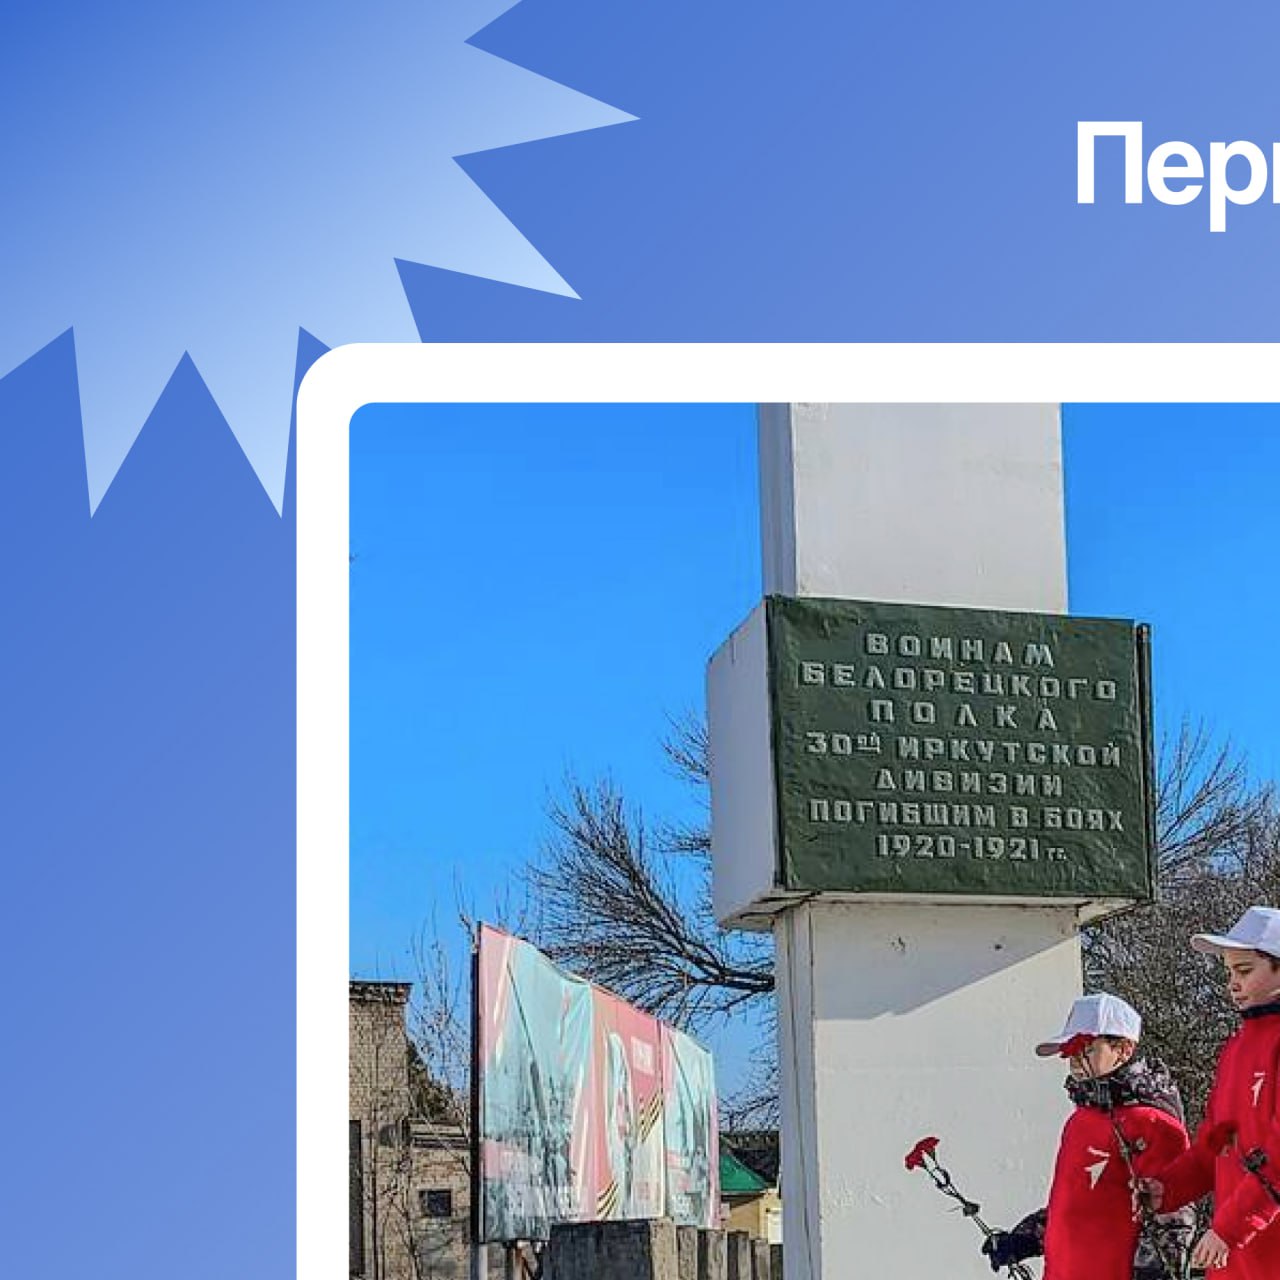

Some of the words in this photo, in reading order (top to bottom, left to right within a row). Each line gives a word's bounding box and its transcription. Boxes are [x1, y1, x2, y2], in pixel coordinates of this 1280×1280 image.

[866, 633, 1055, 666] ВОИНАМ
[802, 661, 1117, 699] БЕЛОРЕЦКОГО
[869, 700, 1058, 730] ПОЛКА
[899, 737, 1120, 766] ИРКУТСКОЙ
[876, 768, 1063, 795] ДИВИЗИИ
[810, 799, 996, 826] ПОГИБШИМ
[1010, 806, 1028, 827] В
[1044, 807, 1124, 831] БОЯХ
[879, 834, 1039, 858] 1920-1921
